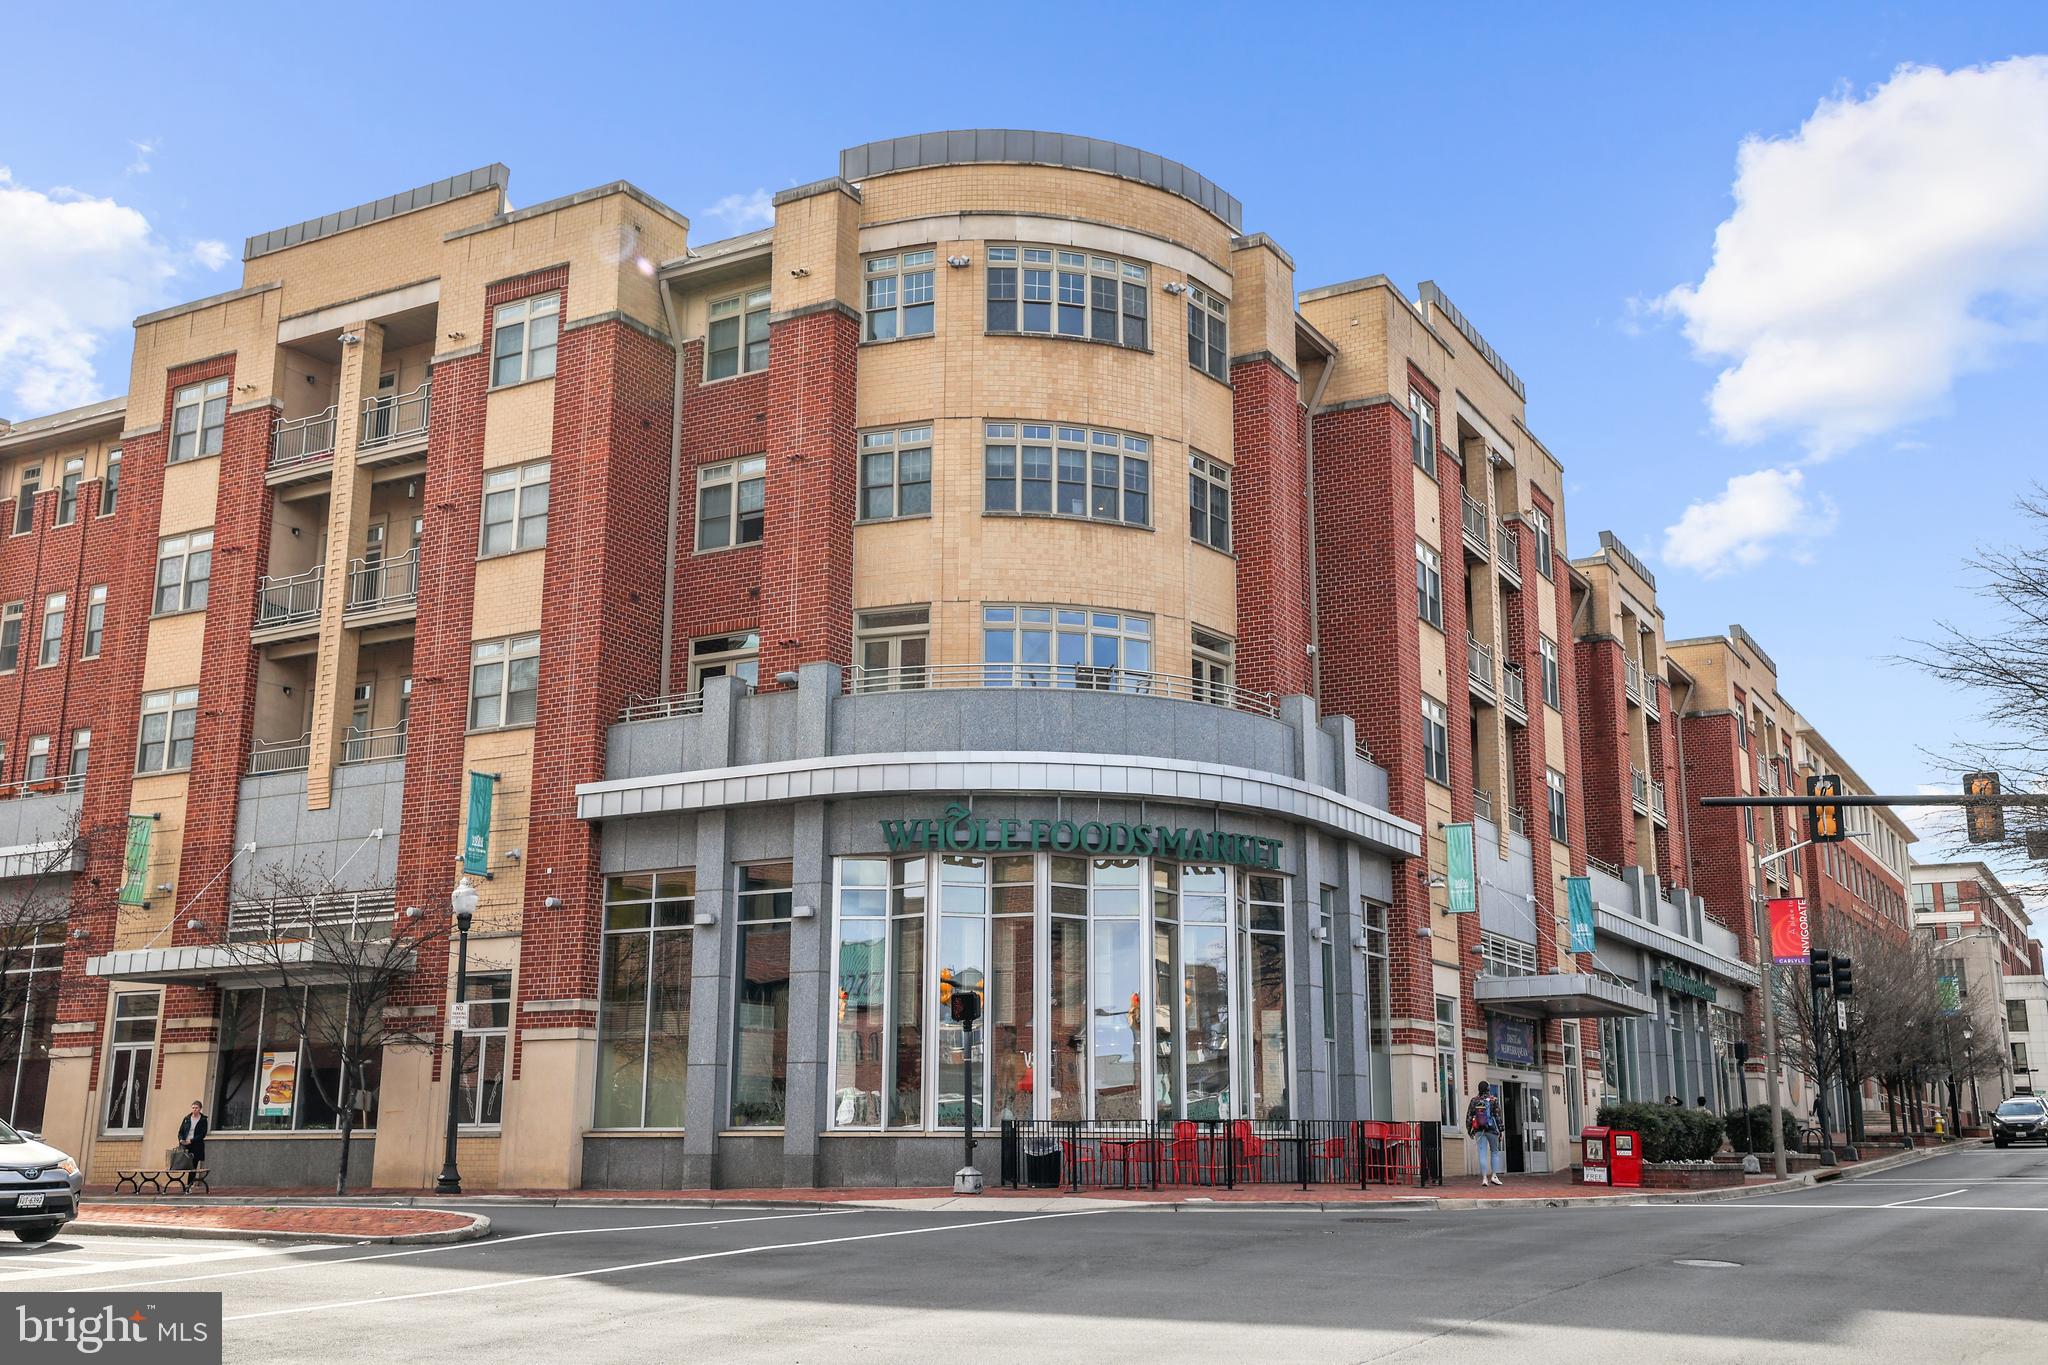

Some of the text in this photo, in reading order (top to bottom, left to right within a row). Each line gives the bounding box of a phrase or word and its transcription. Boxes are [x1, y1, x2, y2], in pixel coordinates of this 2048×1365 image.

[879, 802, 1284, 870] WHOLE FOODS MARKET
[1797, 900, 1811, 956] INVIGORATE
